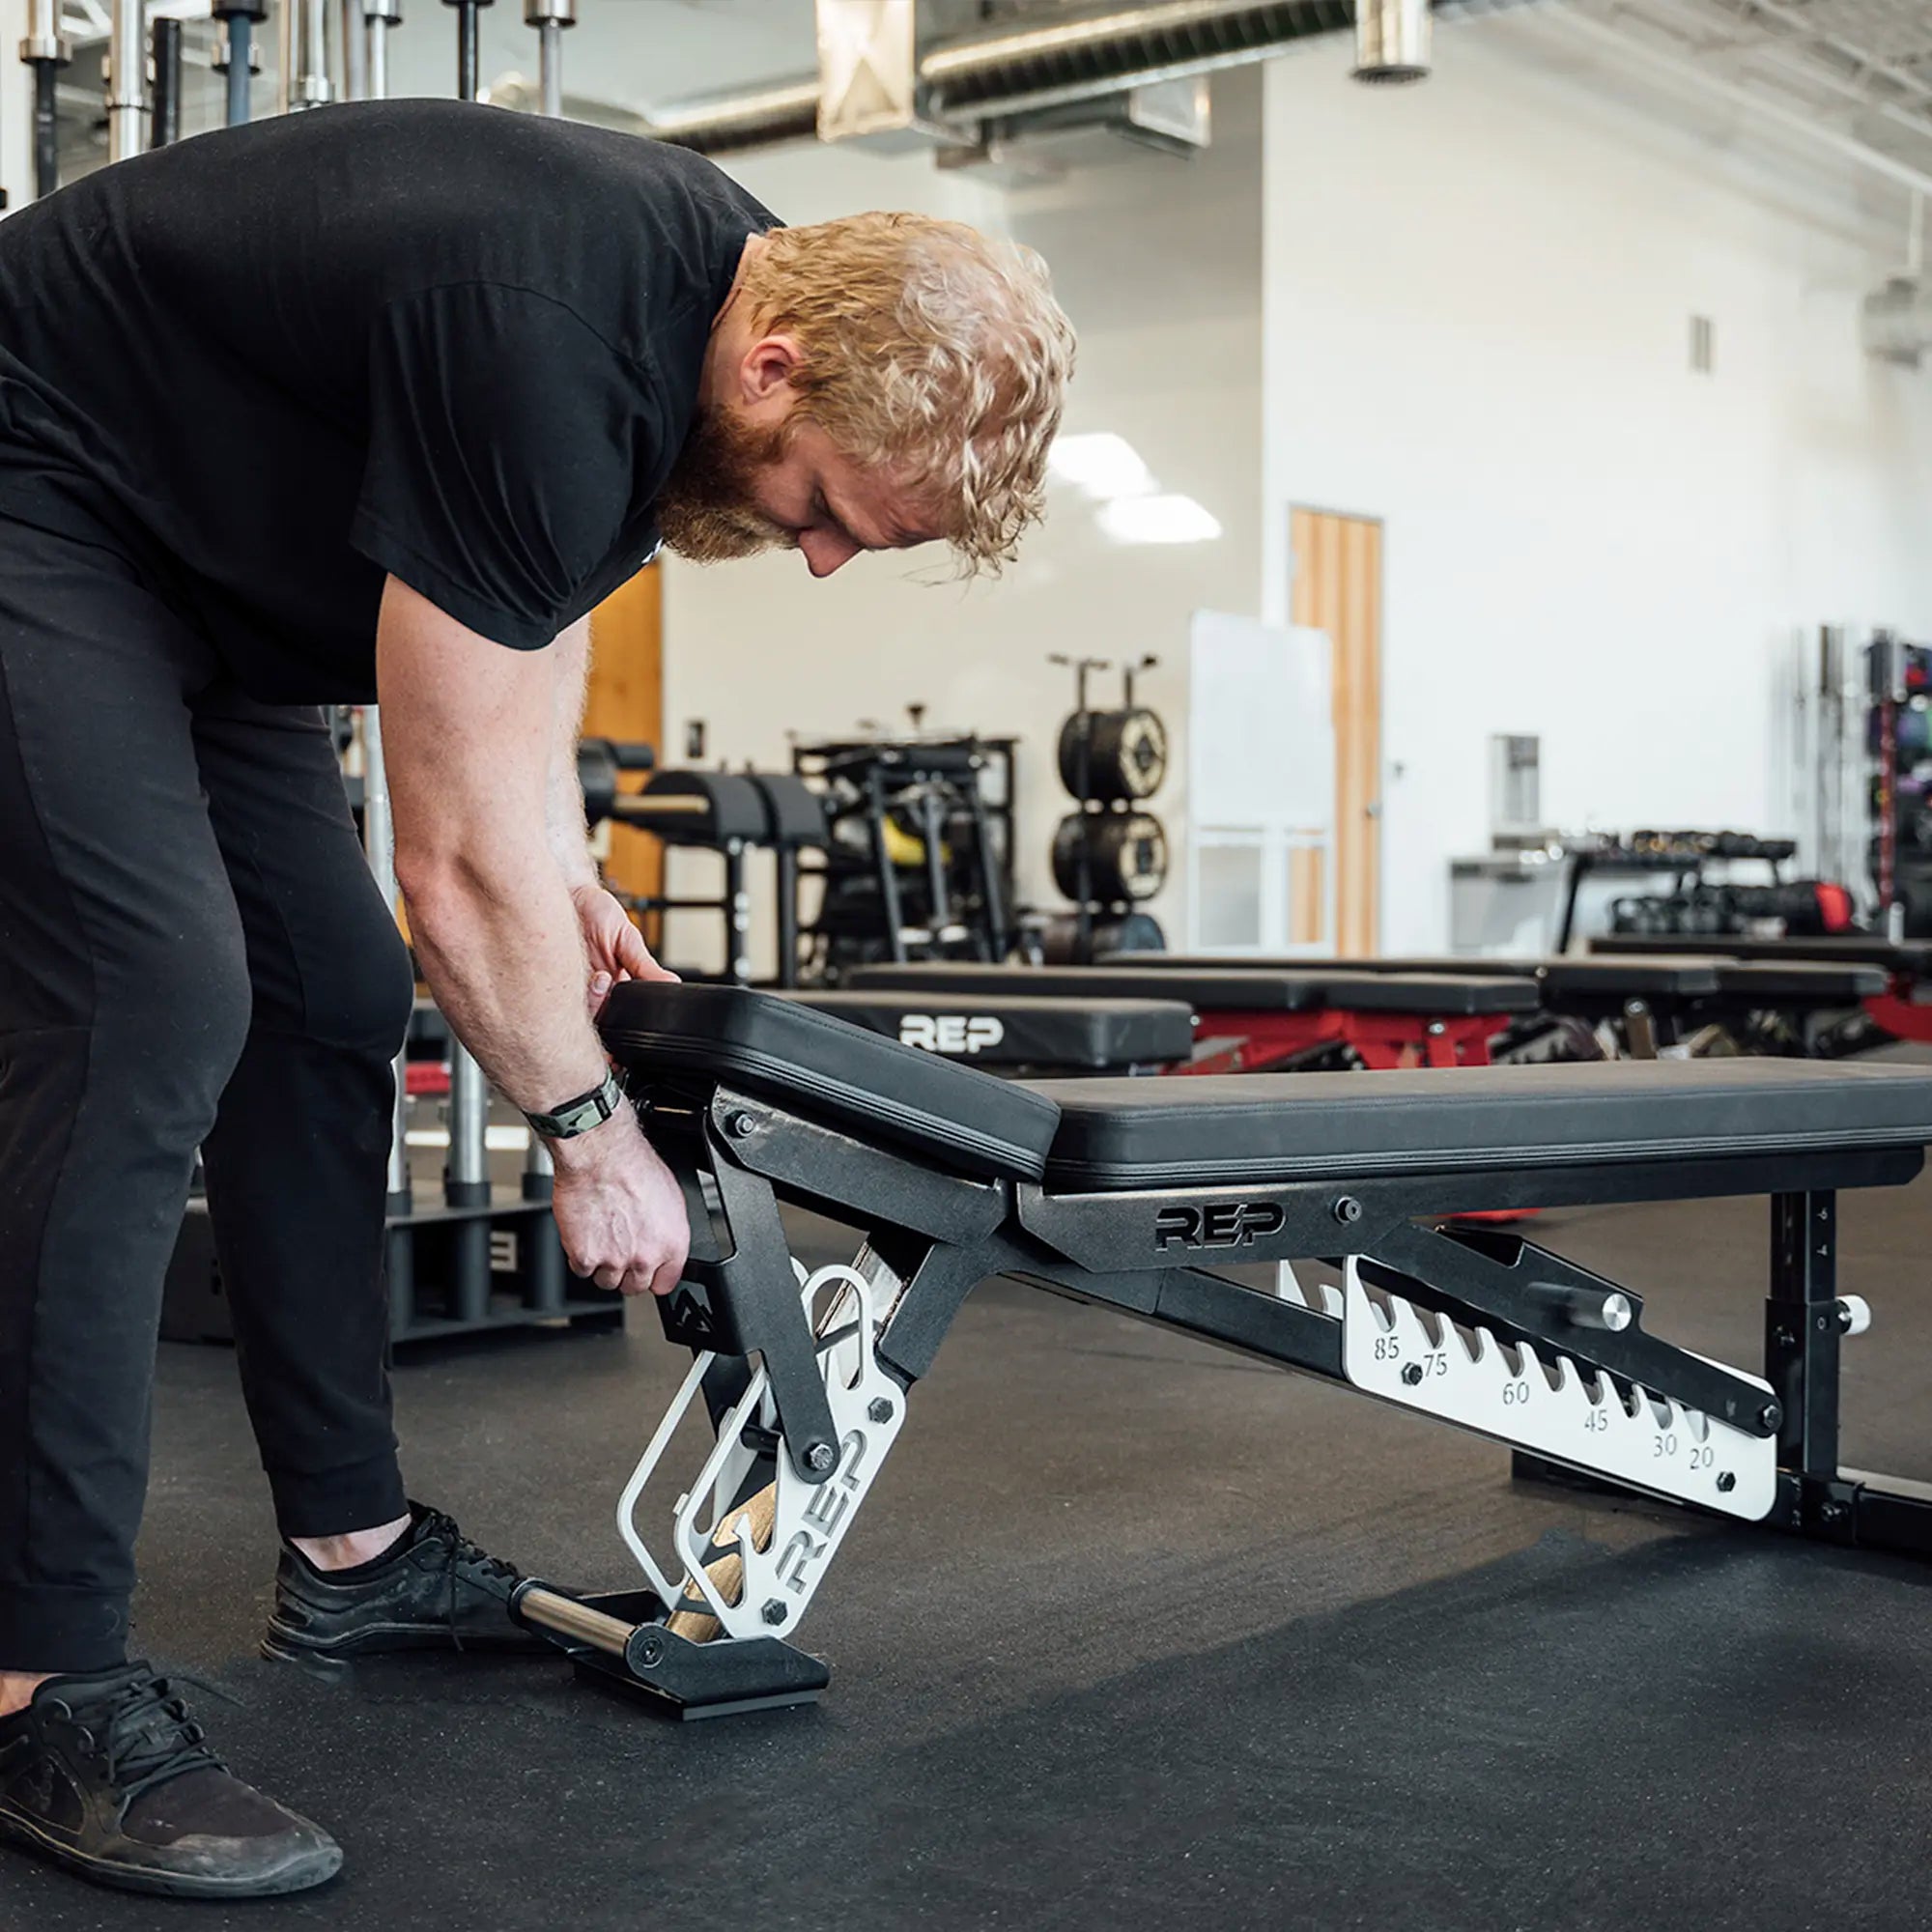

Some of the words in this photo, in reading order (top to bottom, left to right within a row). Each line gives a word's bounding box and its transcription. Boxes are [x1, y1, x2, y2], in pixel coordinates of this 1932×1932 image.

[899, 1014, 1005, 1054] REP
[1156, 1203, 1286, 1251] REP
[1375, 1336, 1400, 1360] 85
[1423, 1353, 1447, 1378] 75
[1502, 1381, 1529, 1405] 60
[1584, 1409, 1608, 1432] 45
[1653, 1434, 1677, 1457] 30
[1690, 1446, 1714, 1469] 20
[775, 1429, 867, 1595] REP
